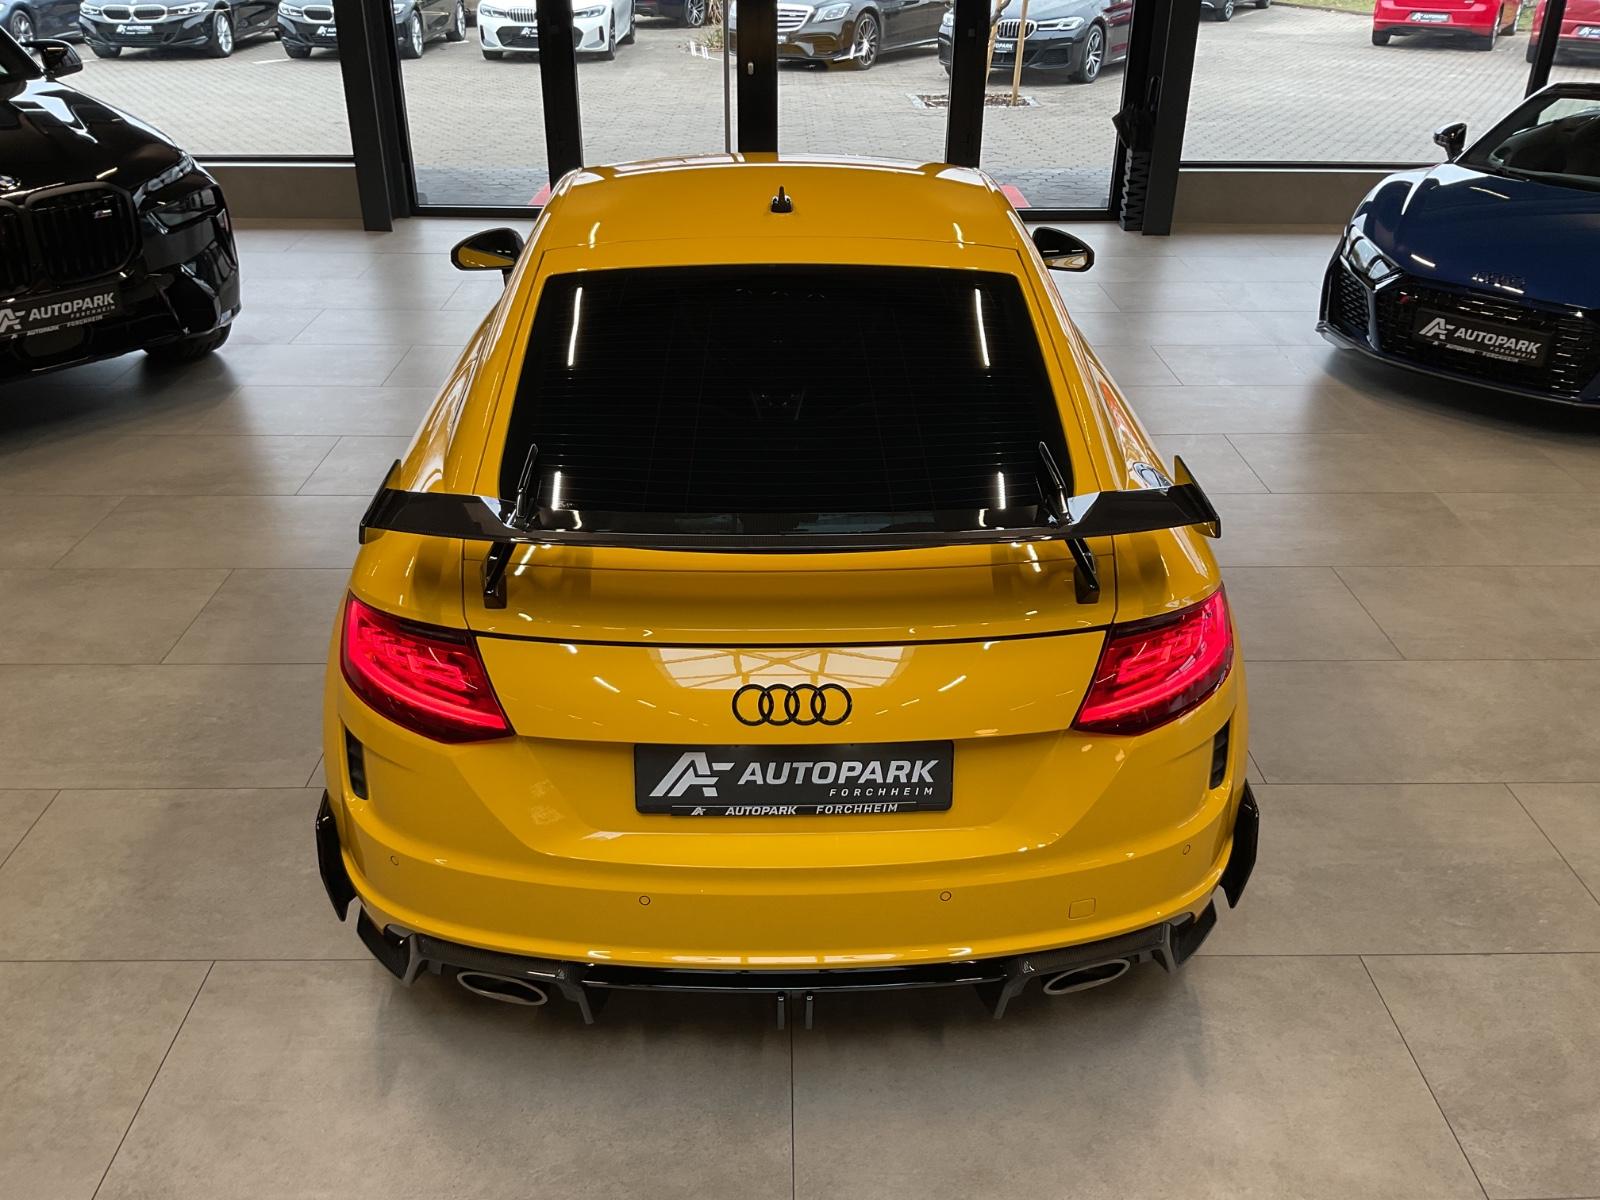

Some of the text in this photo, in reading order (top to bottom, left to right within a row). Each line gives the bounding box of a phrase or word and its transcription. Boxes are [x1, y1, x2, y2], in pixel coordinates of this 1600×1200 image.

[29, 292, 114, 321] AUTOPARK
[1454, 327, 1542, 354] AUTOPARK
[737, 760, 940, 786] AUTOPARK
[829, 787, 934, 798] FORCHHEIM
[725, 805, 798, 817] AUTOPARK
[816, 803, 898, 815] FORCHHEIM
